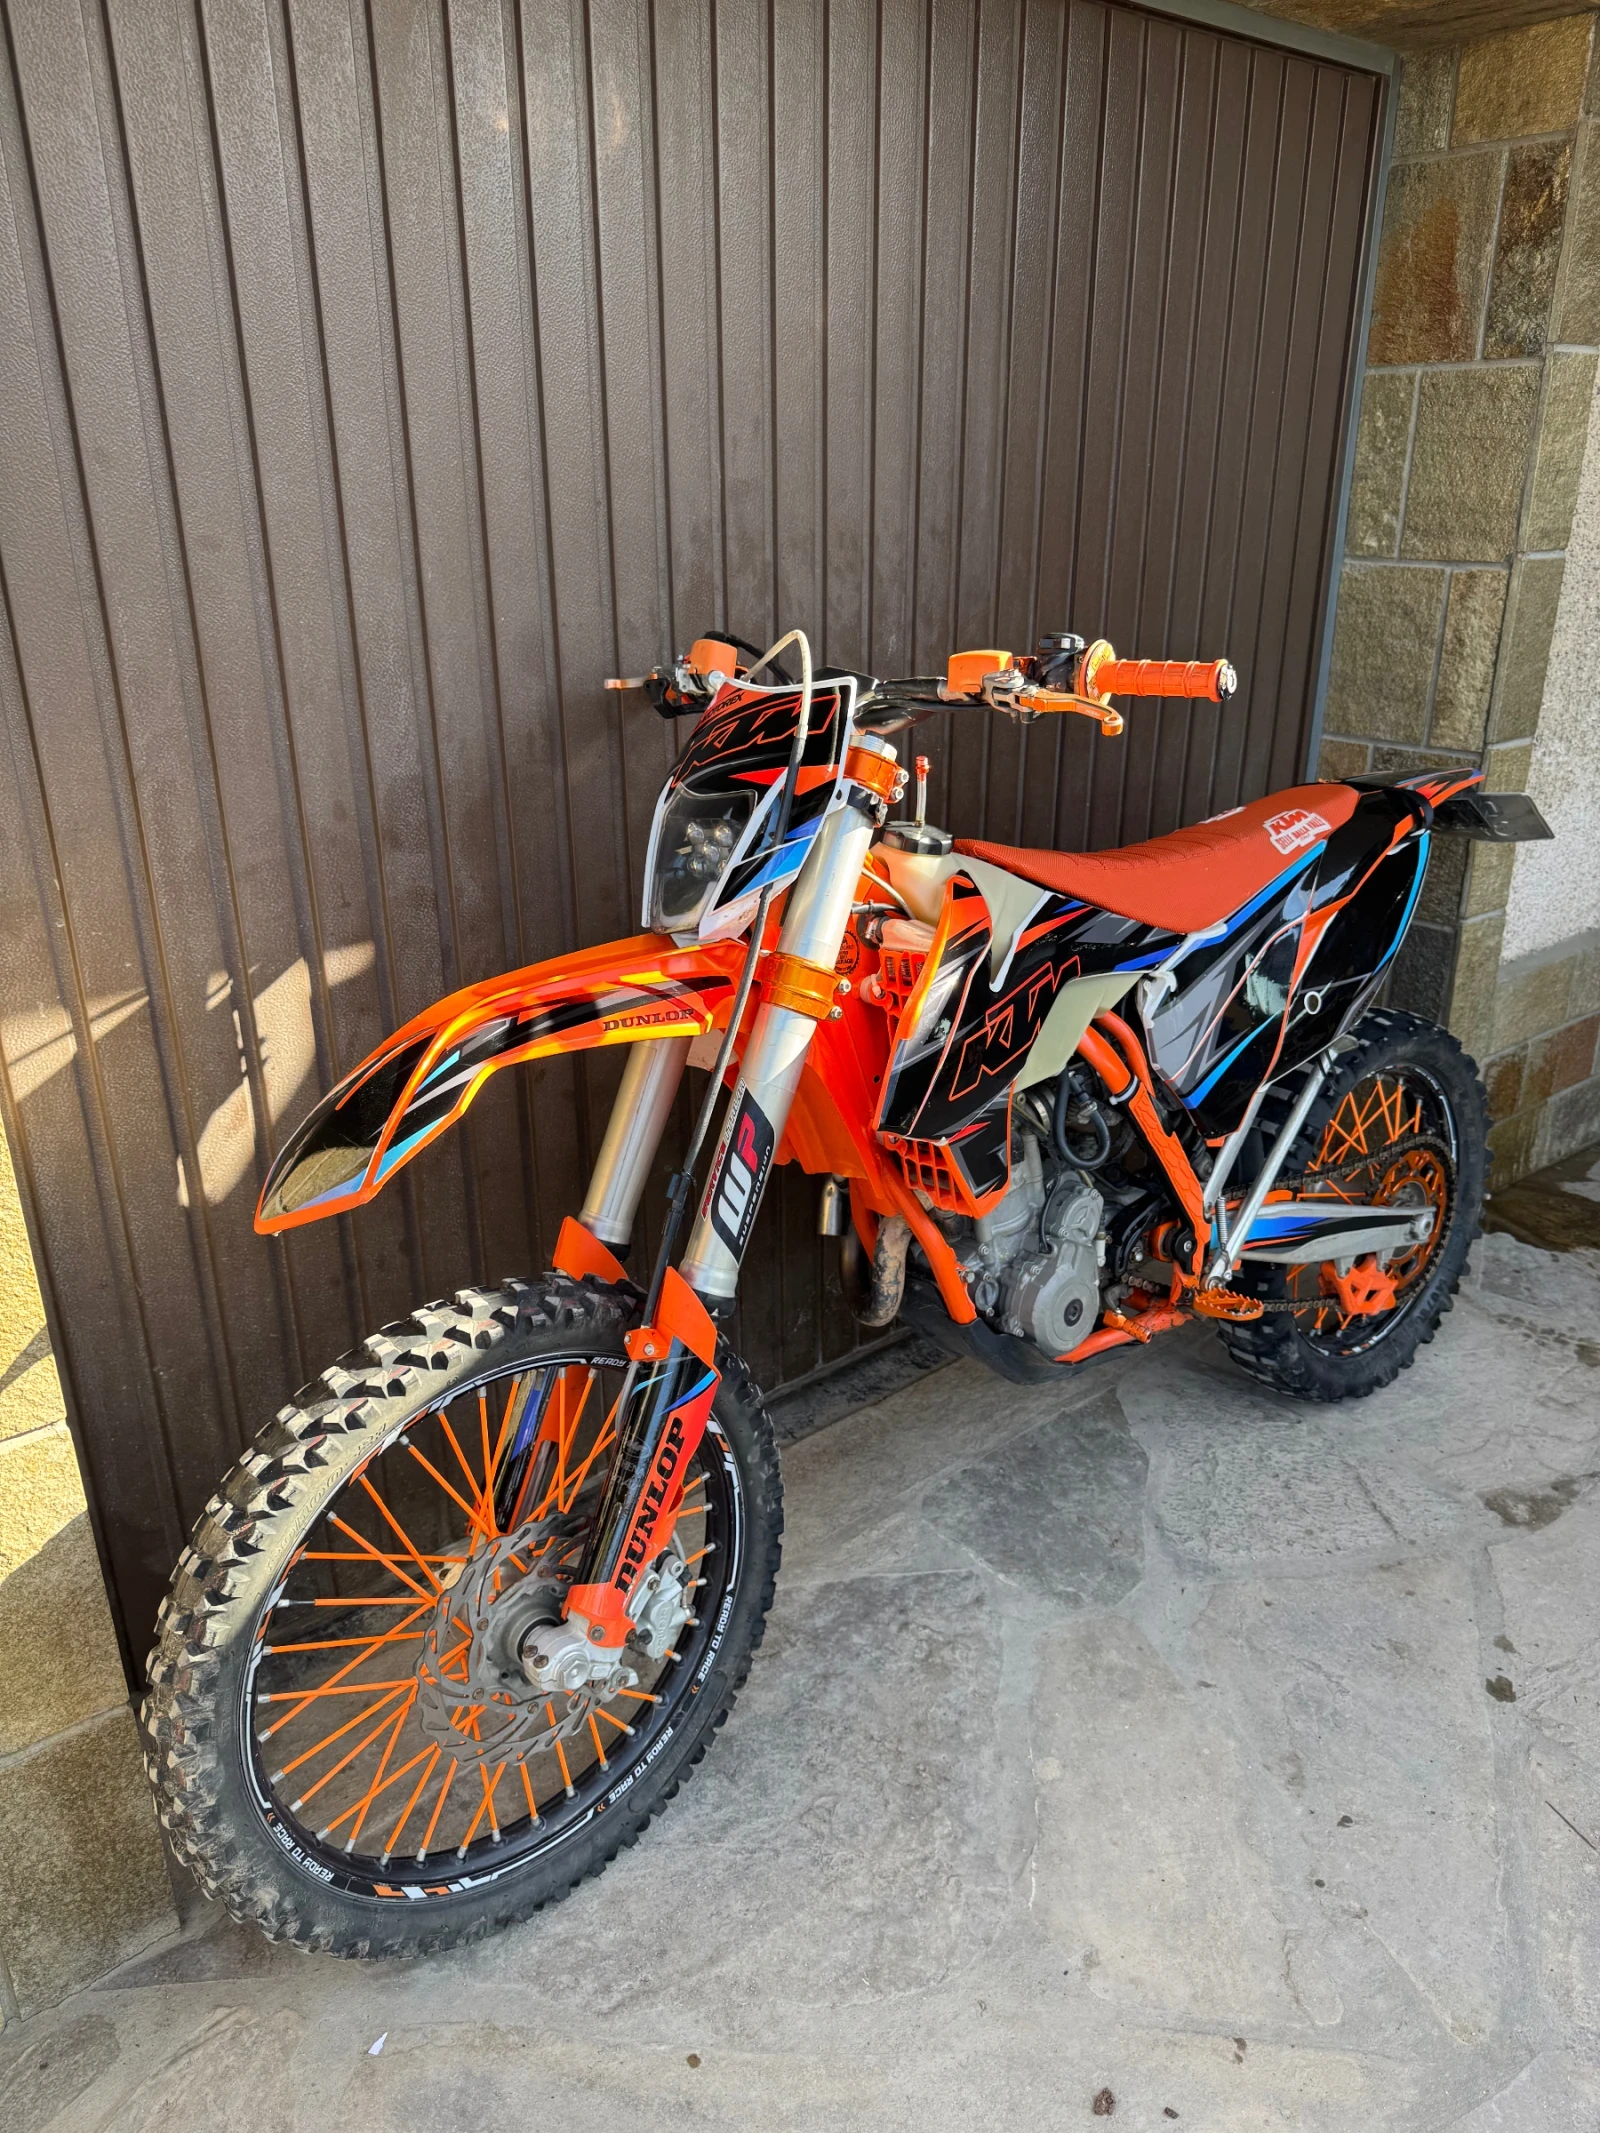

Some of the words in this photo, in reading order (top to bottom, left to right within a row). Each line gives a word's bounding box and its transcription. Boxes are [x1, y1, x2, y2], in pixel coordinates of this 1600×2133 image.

[1269, 811, 1309, 836] KTM
[602, 1008, 694, 1032] DUNLOP
[590, 1356, 627, 1368] READY
[614, 1416, 687, 1597] DUNLOP
[716, 1595, 733, 1634] READY
[711, 1633, 722, 1650] TO
[697, 1649, 716, 1683] RACE
[646, 1726, 674, 1765] READY
[633, 1761, 648, 1777] TO
[608, 1775, 634, 1805] RACE
[272, 1822, 296, 1850] RACE
[291, 1847, 305, 1862] TO
[302, 1857, 335, 1882] READY
